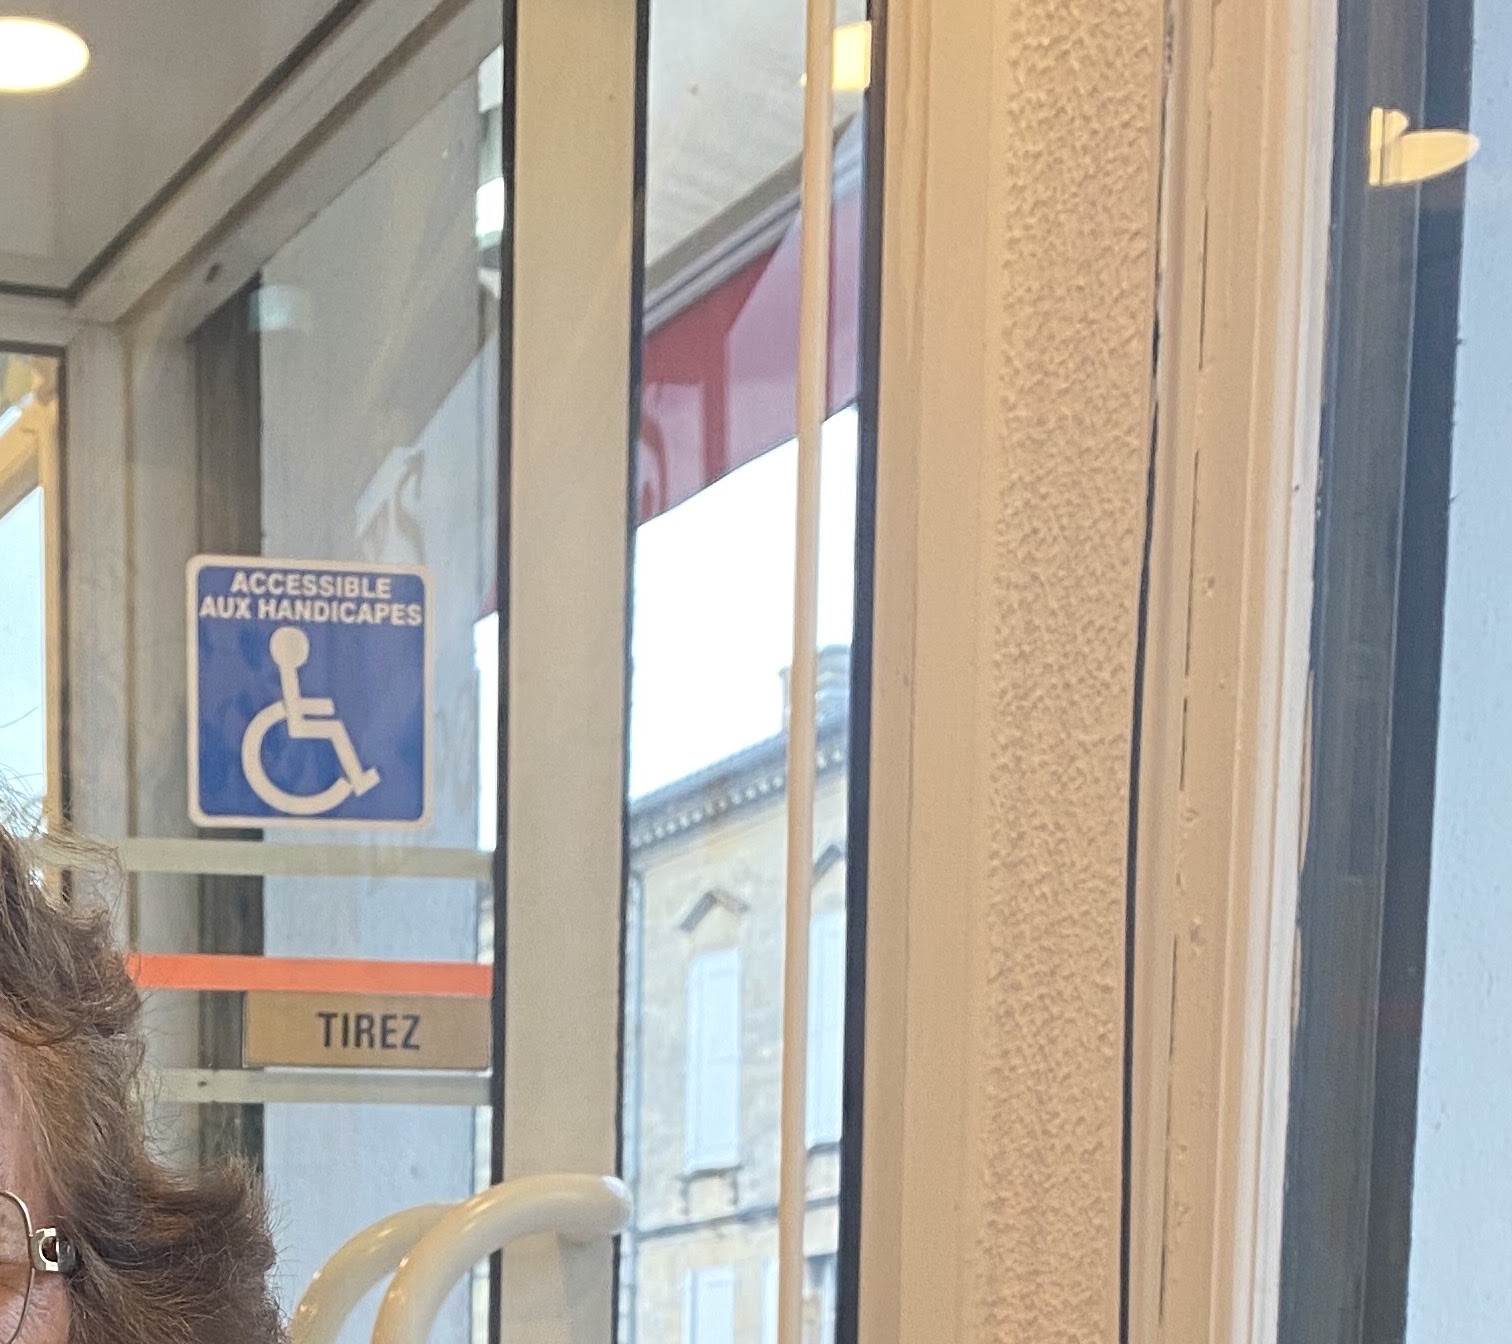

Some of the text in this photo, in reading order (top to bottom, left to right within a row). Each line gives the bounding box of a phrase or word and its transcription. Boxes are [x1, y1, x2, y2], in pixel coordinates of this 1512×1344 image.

[231, 571, 392, 599] ACCESSIBLE
[199, 596, 423, 626] AUX HANDICAPES
[318, 1011, 420, 1050] TIREZ
